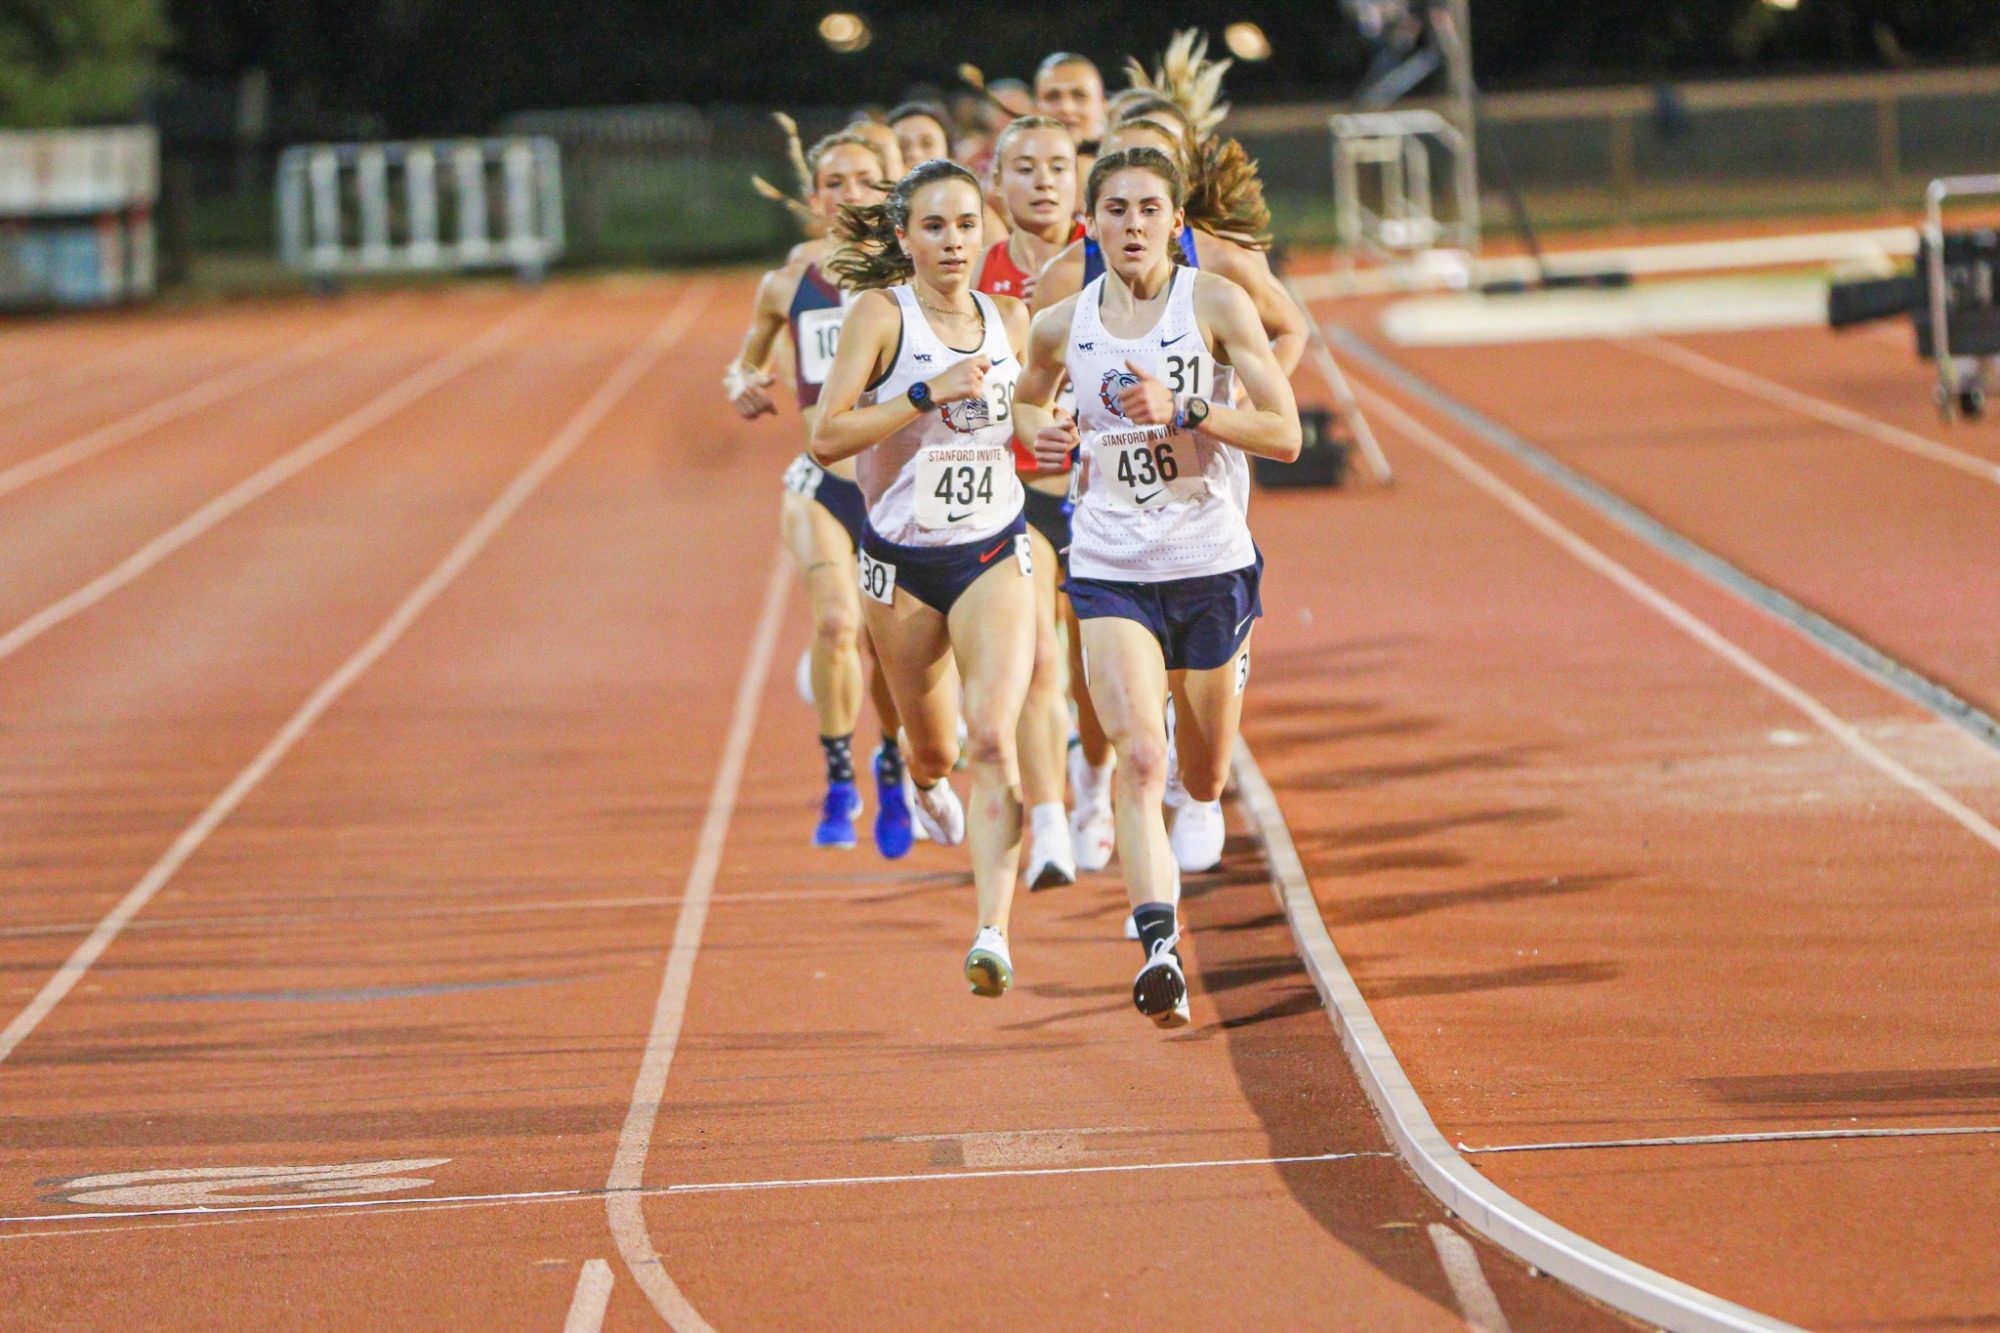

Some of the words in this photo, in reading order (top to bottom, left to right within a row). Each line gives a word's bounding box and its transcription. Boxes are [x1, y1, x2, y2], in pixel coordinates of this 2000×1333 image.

[1167, 355, 1200, 394] 31
[929, 449, 975, 462] STANFORD
[976, 448, 1002, 461] INVITE
[1101, 431, 1147, 447] STANFORD
[1147, 424, 1179, 441] INVITE
[1117, 443, 1179, 488] 436
[934, 466, 994, 505] 434
[863, 555, 887, 599] 30
